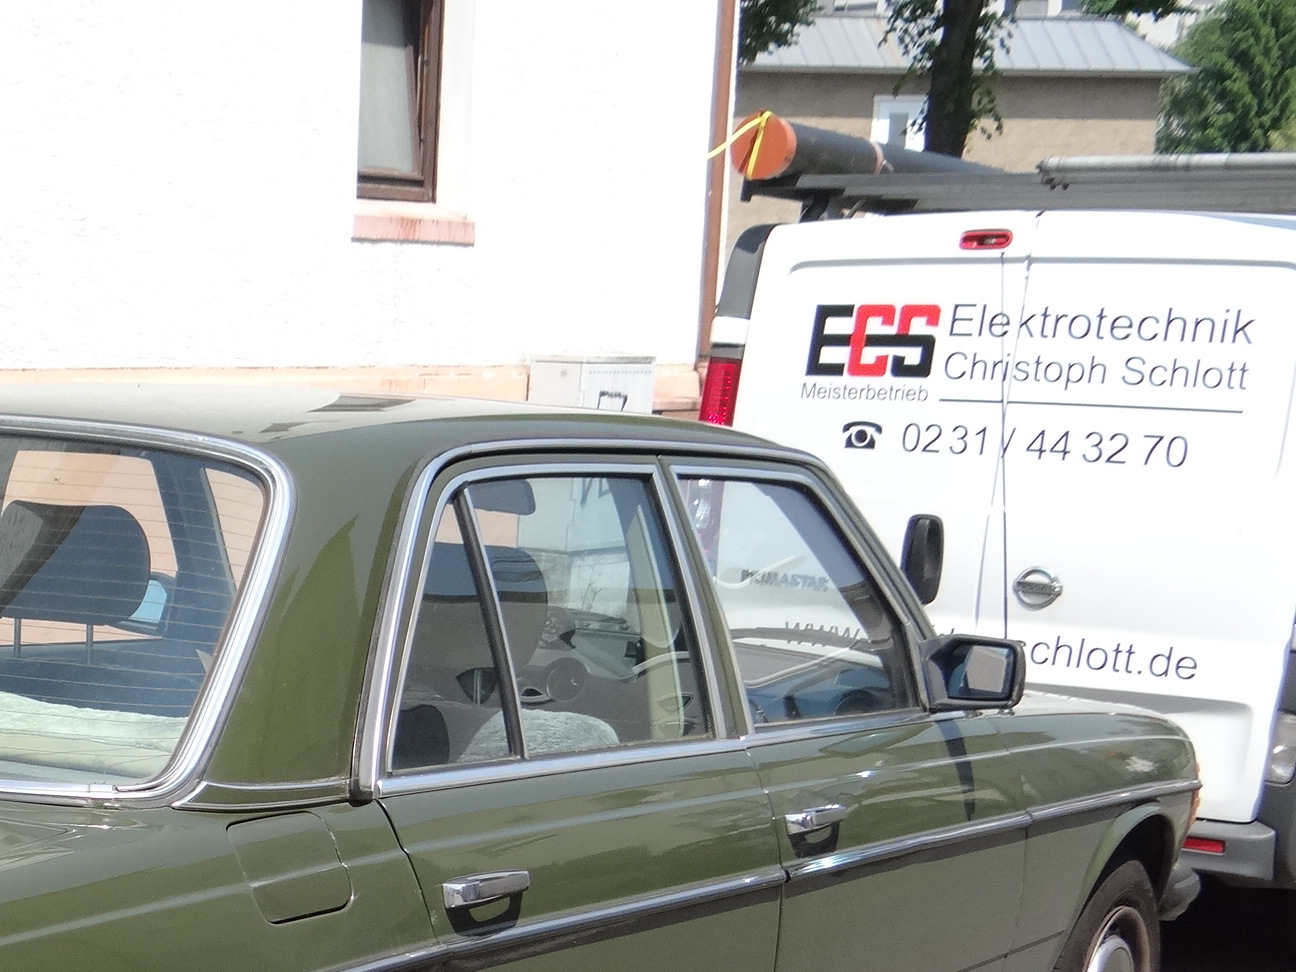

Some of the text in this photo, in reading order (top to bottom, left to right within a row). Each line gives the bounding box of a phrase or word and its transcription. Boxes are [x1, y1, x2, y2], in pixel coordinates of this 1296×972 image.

[949, 304, 1255, 344] Elektrotechnik
[944, 351, 1249, 391] Christoph Schlott
[800, 382, 929, 402] Meisterbetrieb
[1022, 635, 1198, 680] chlott.de
